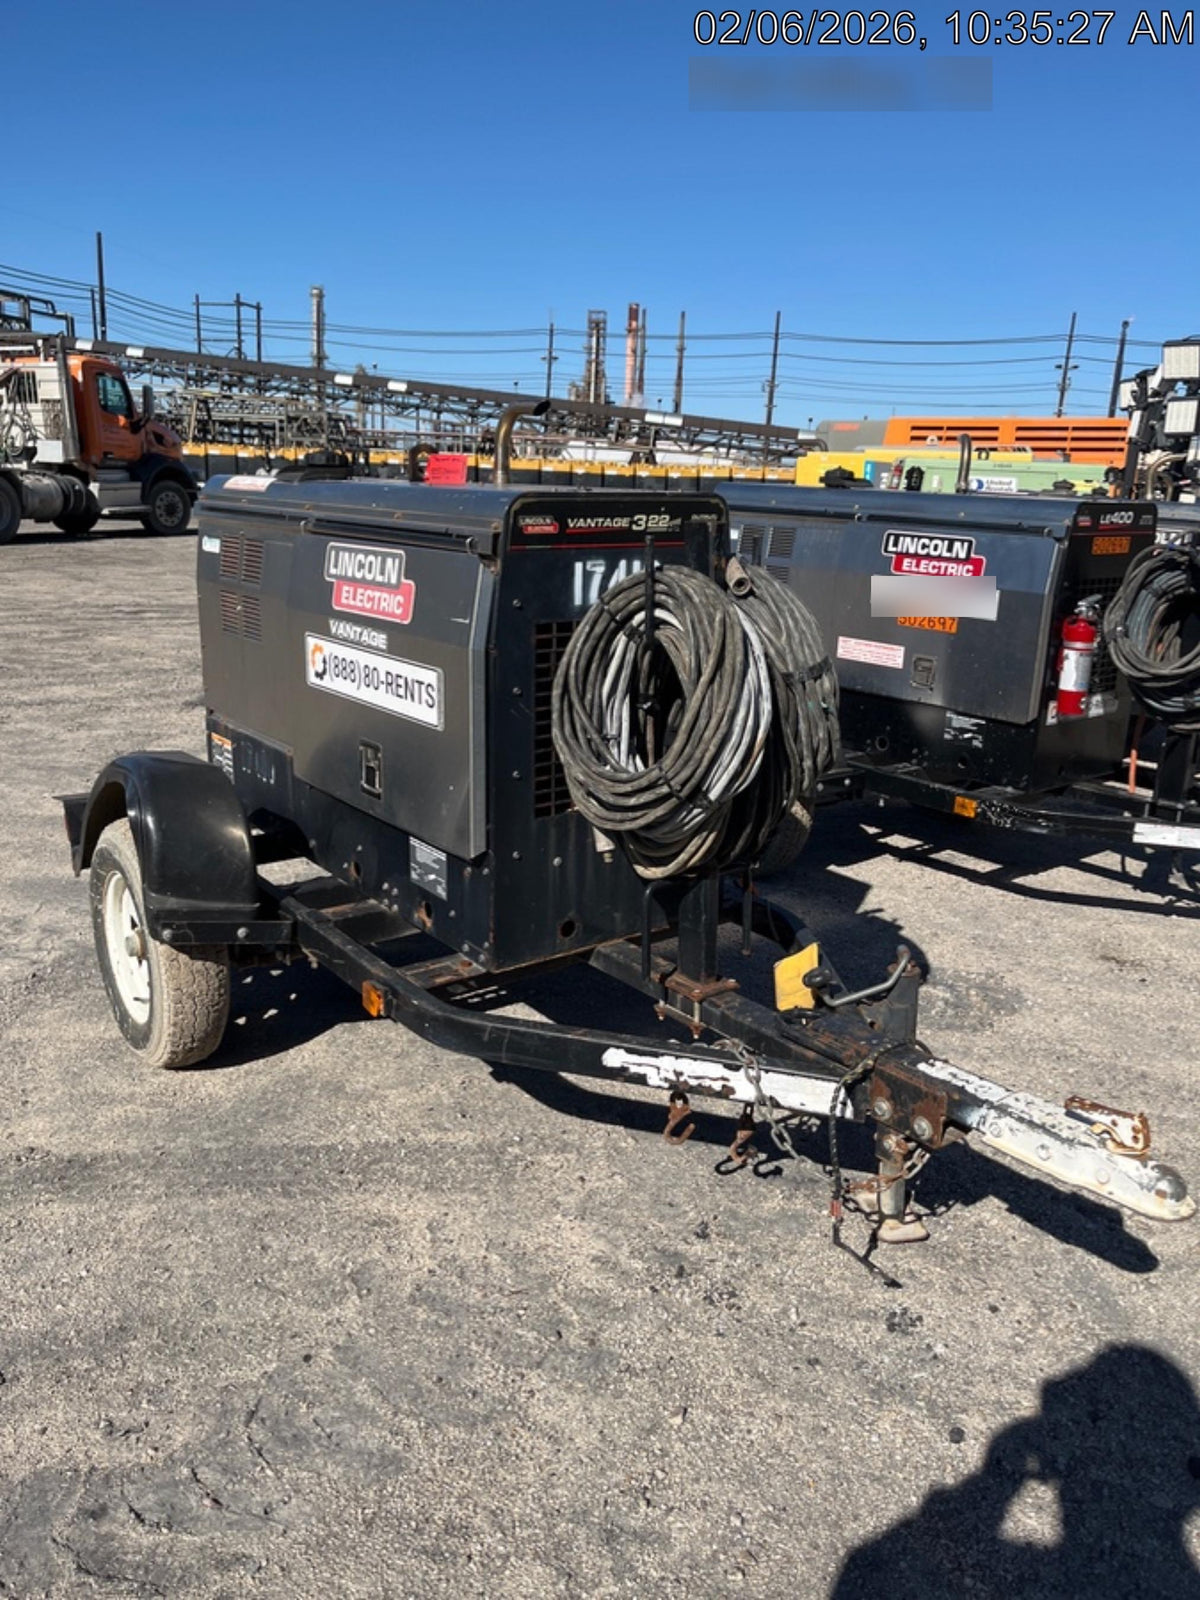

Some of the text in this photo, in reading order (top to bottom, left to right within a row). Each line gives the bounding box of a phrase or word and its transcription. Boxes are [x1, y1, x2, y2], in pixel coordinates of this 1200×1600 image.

[567, 517, 631, 529] VANTAGE
[631, 514, 671, 531] 322
[886, 534, 969, 560] LINCOLN
[328, 550, 400, 585] LINCOLN
[901, 557, 974, 577] ELECTRIC
[340, 585, 405, 615] ELECTRIC
[328, 617, 389, 650] VANTAGE
